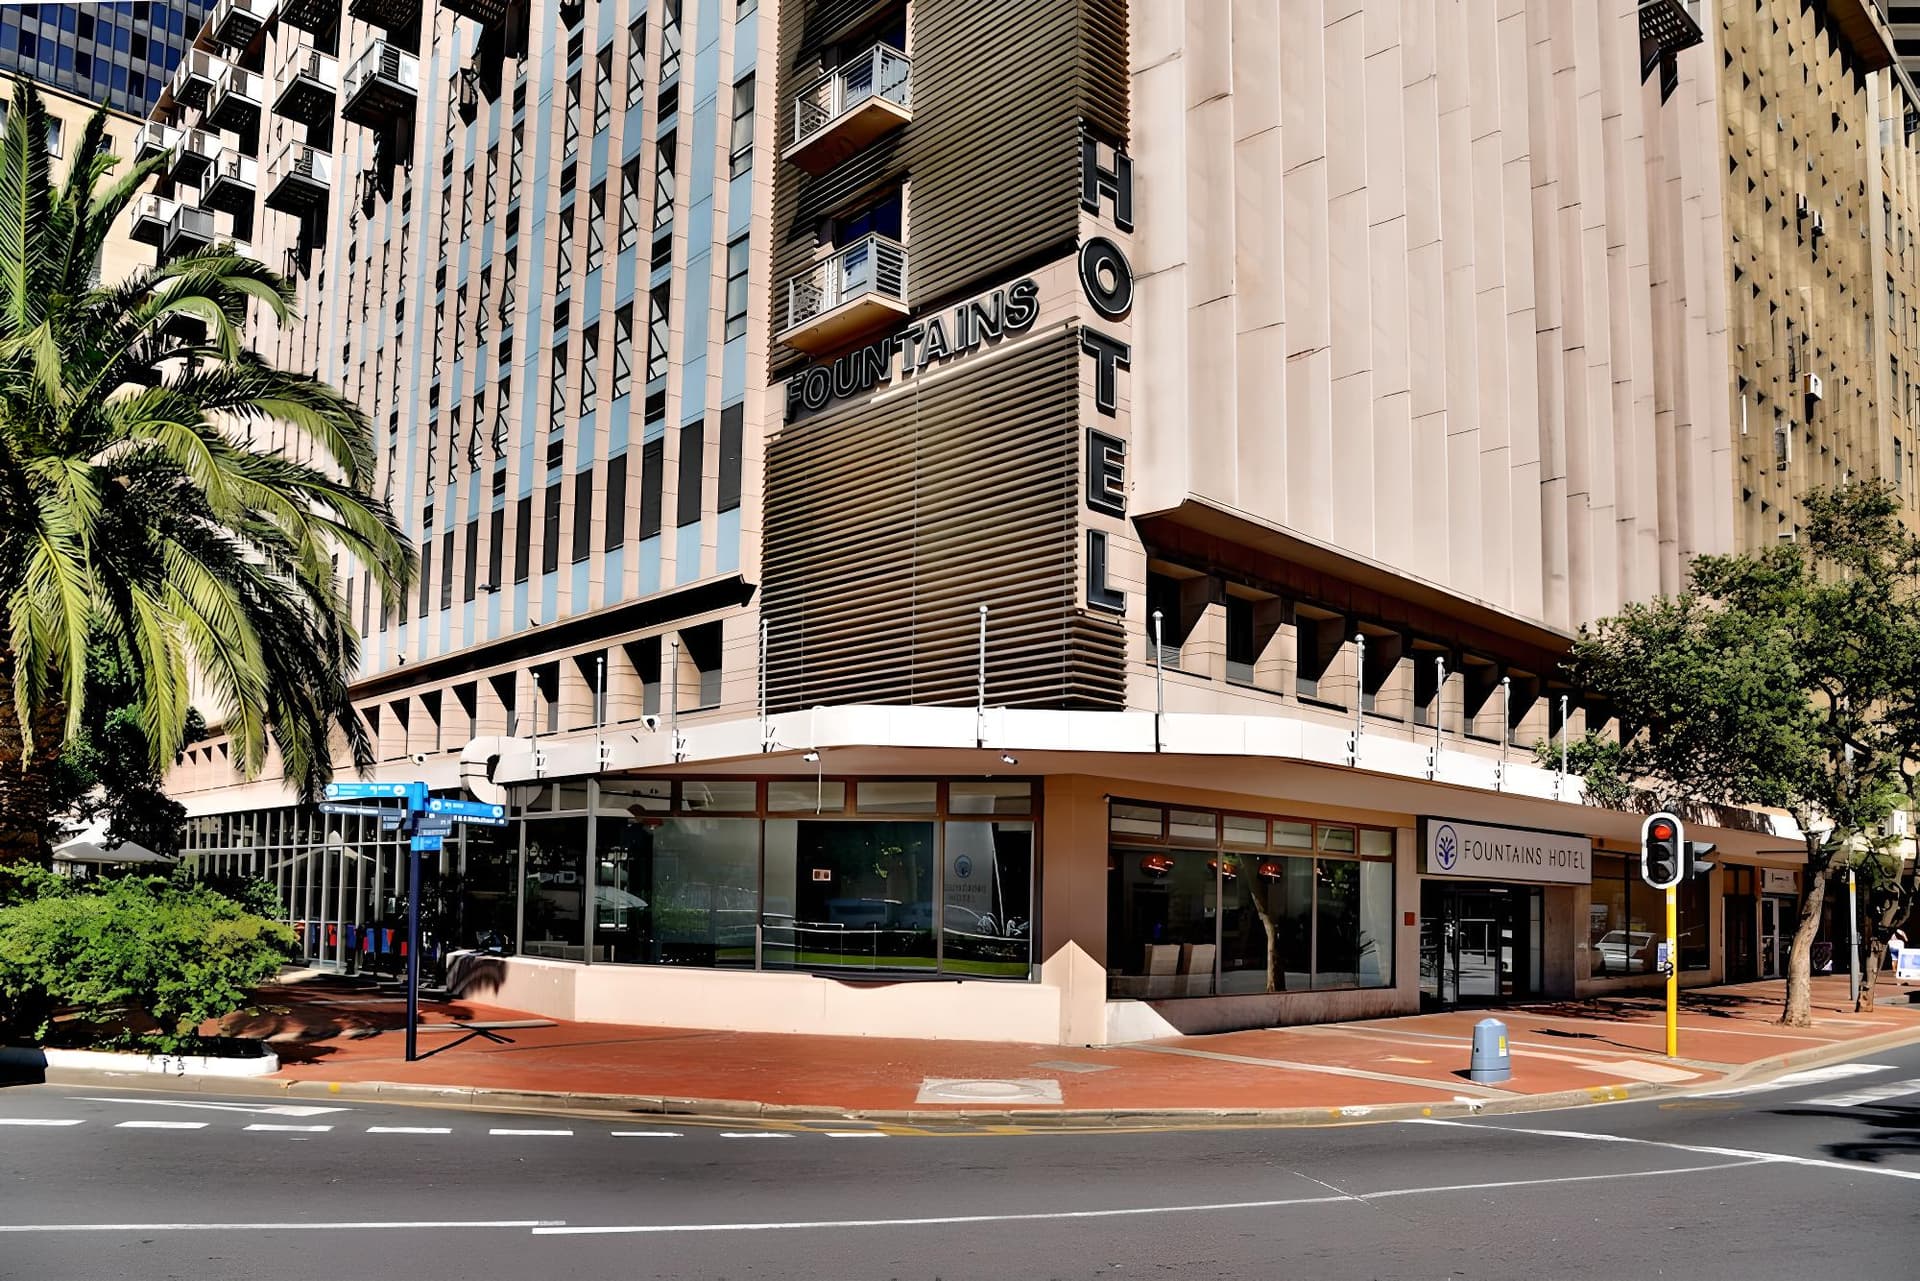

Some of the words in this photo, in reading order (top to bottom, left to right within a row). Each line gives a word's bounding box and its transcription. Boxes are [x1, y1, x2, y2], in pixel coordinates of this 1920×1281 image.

[783, 277, 1040, 422] FOUNTAINS
[1077, 130, 1135, 615] HOTEL
[1464, 840, 1542, 866] FOUNTAINS
[1548, 848, 1585, 870] HOTEL
